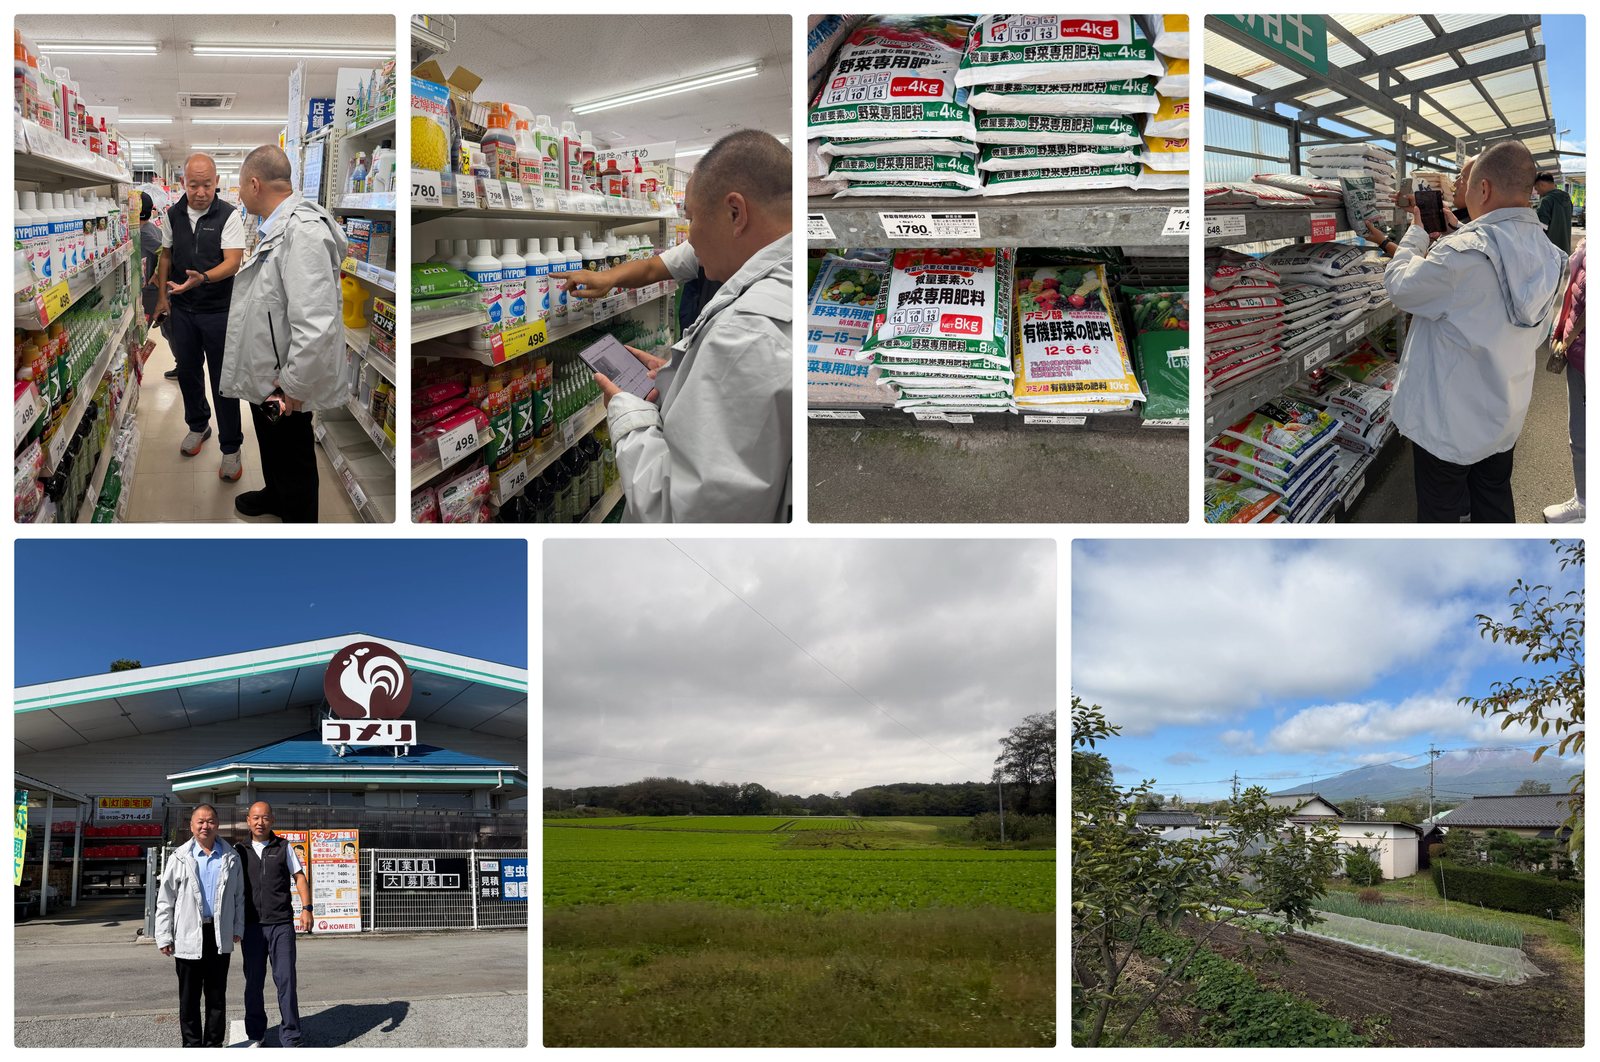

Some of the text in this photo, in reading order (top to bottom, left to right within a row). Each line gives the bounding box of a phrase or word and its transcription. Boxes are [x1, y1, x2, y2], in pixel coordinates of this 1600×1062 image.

[1080, 22, 1114, 37] 4kg
[1234, 14, 1316, 63] 用土
[970, 51, 1022, 63] 微量要素入り
[1024, 44, 1100, 61] 野菜専用肥料
[1118, 46, 1146, 58] 4kg
[908, 80, 939, 94] 4kg
[1122, 78, 1149, 93] 4kg
[811, 109, 856, 122] 微量要素入り
[858, 104, 924, 120] 野菜専用肥料
[940, 104, 964, 118] 4kg
[980, 118, 1027, 129] 微量要素入り
[1028, 116, 1094, 132] 野菜専用肥料
[1109, 119, 1133, 134] 4kg
[876, 157, 934, 171] 野菜専用肥料
[948, 158, 970, 172] 4kg
[896, 225, 928, 234] 1780
[1207, 226, 1220, 234] 648
[916, 274, 974, 286] 微量要素入り
[897, 288, 986, 309] 野菜専用肥料
[1025, 310, 1063, 321] アミノ酸
[954, 318, 979, 332] 8kg
[1024, 321, 1113, 343] 有機野菜の肥料
[528, 332, 544, 348] 498
[911, 339, 966, 352] 野菜専用肥料
[979, 342, 998, 356] 8kg
[834, 348, 854, 356] NET
[1044, 345, 1092, 355] 12-6-6
[1026, 382, 1129, 393] アミノ酸 有機野菜の肥料 10kg
[22, 404, 34, 424] 498
[455, 433, 475, 452] 498
[510, 472, 525, 489] 748
[327, 724, 412, 741] コメリ
[382, 860, 432, 871] 従業員
[504, 865, 528, 878] 害虫
[388, 876, 452, 887] 大募集!
[481, 876, 499, 886] 見積
[481, 888, 499, 897] 無料
